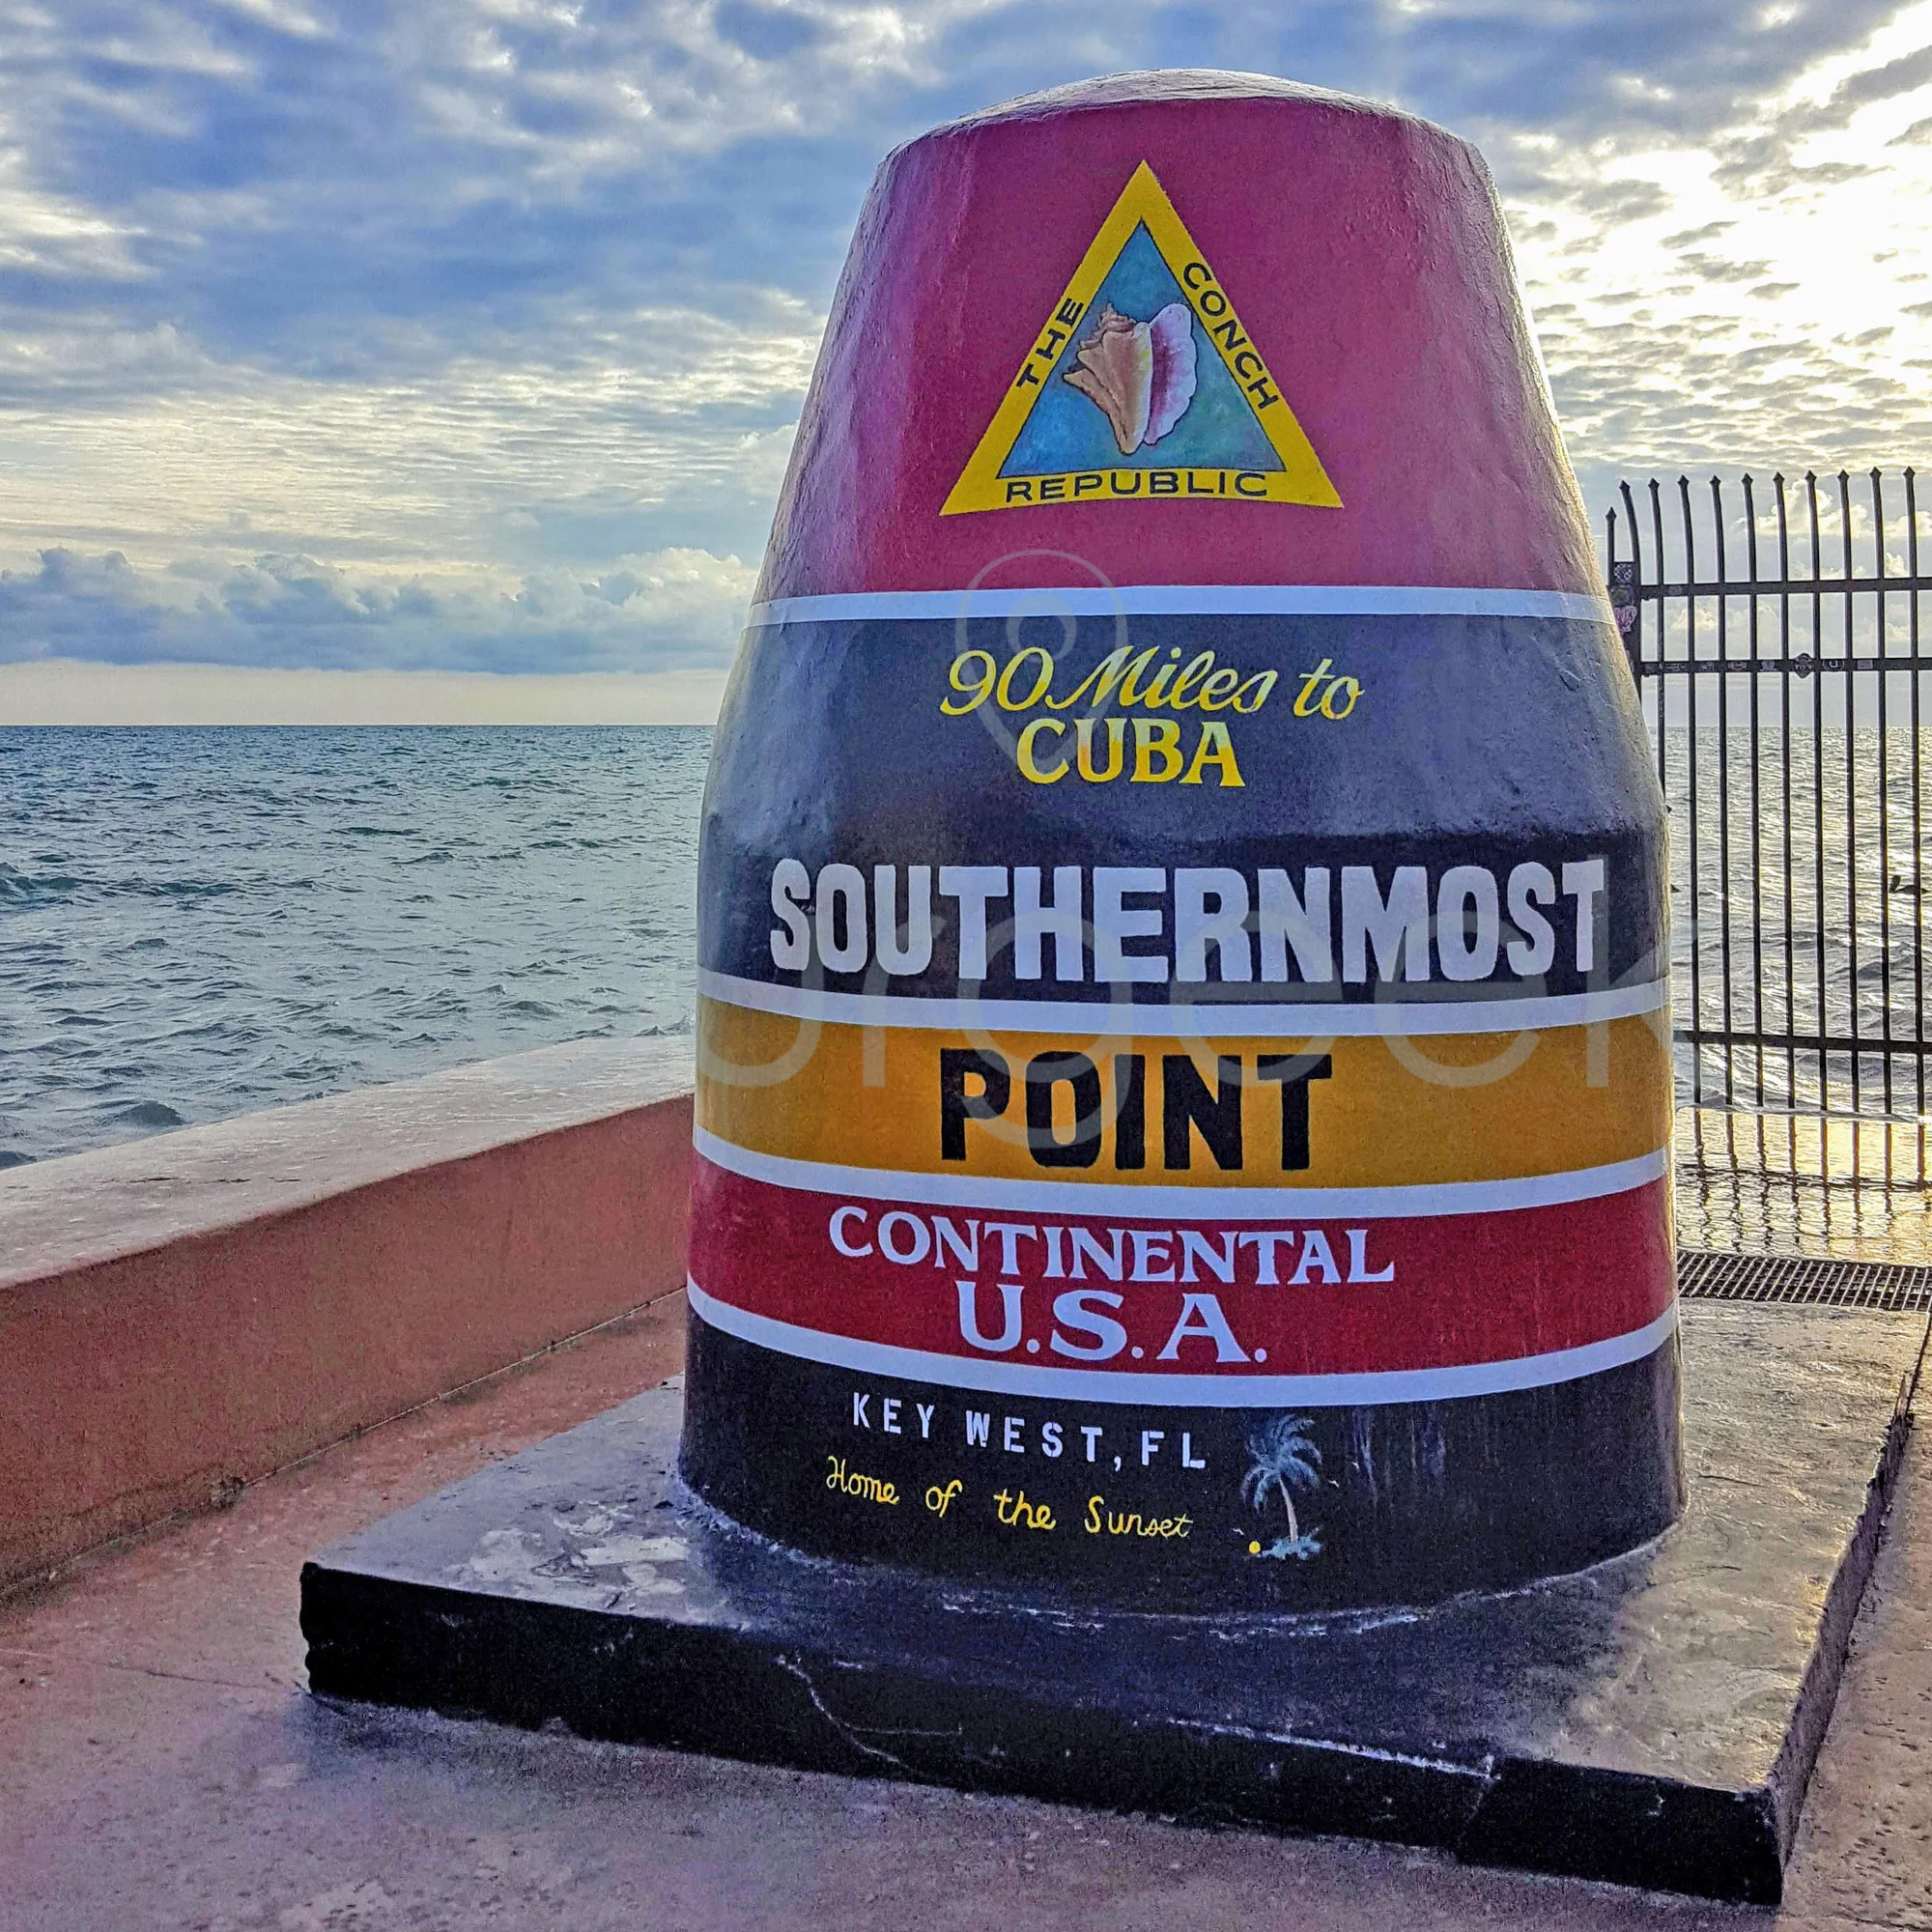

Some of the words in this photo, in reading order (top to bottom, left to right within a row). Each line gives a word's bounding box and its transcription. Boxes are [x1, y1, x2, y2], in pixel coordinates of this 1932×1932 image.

[1016, 298, 1084, 388] THE
[1183, 262, 1278, 410] CONCH
[1006, 471, 1268, 503] REPUBLIC
[940, 646, 1054, 716] 90
[1045, 644, 1278, 714] Miles
[1294, 658, 1365, 720] to
[1016, 718, 1245, 787] CUBA
[769, 858, 1605, 985] SOUTHERNMOST
[940, 1048, 1332, 1172] POINT
[828, 1205, 1395, 1286] CONTINENTAL
[955, 1280, 1267, 1363] U.S.A.
[852, 1392, 935, 1438] KEY
[826, 1455, 899, 1506] Home
[925, 1480, 963, 1519] of
[993, 1488, 1057, 1530] the
[1084, 1494, 1194, 1539] Sunset
